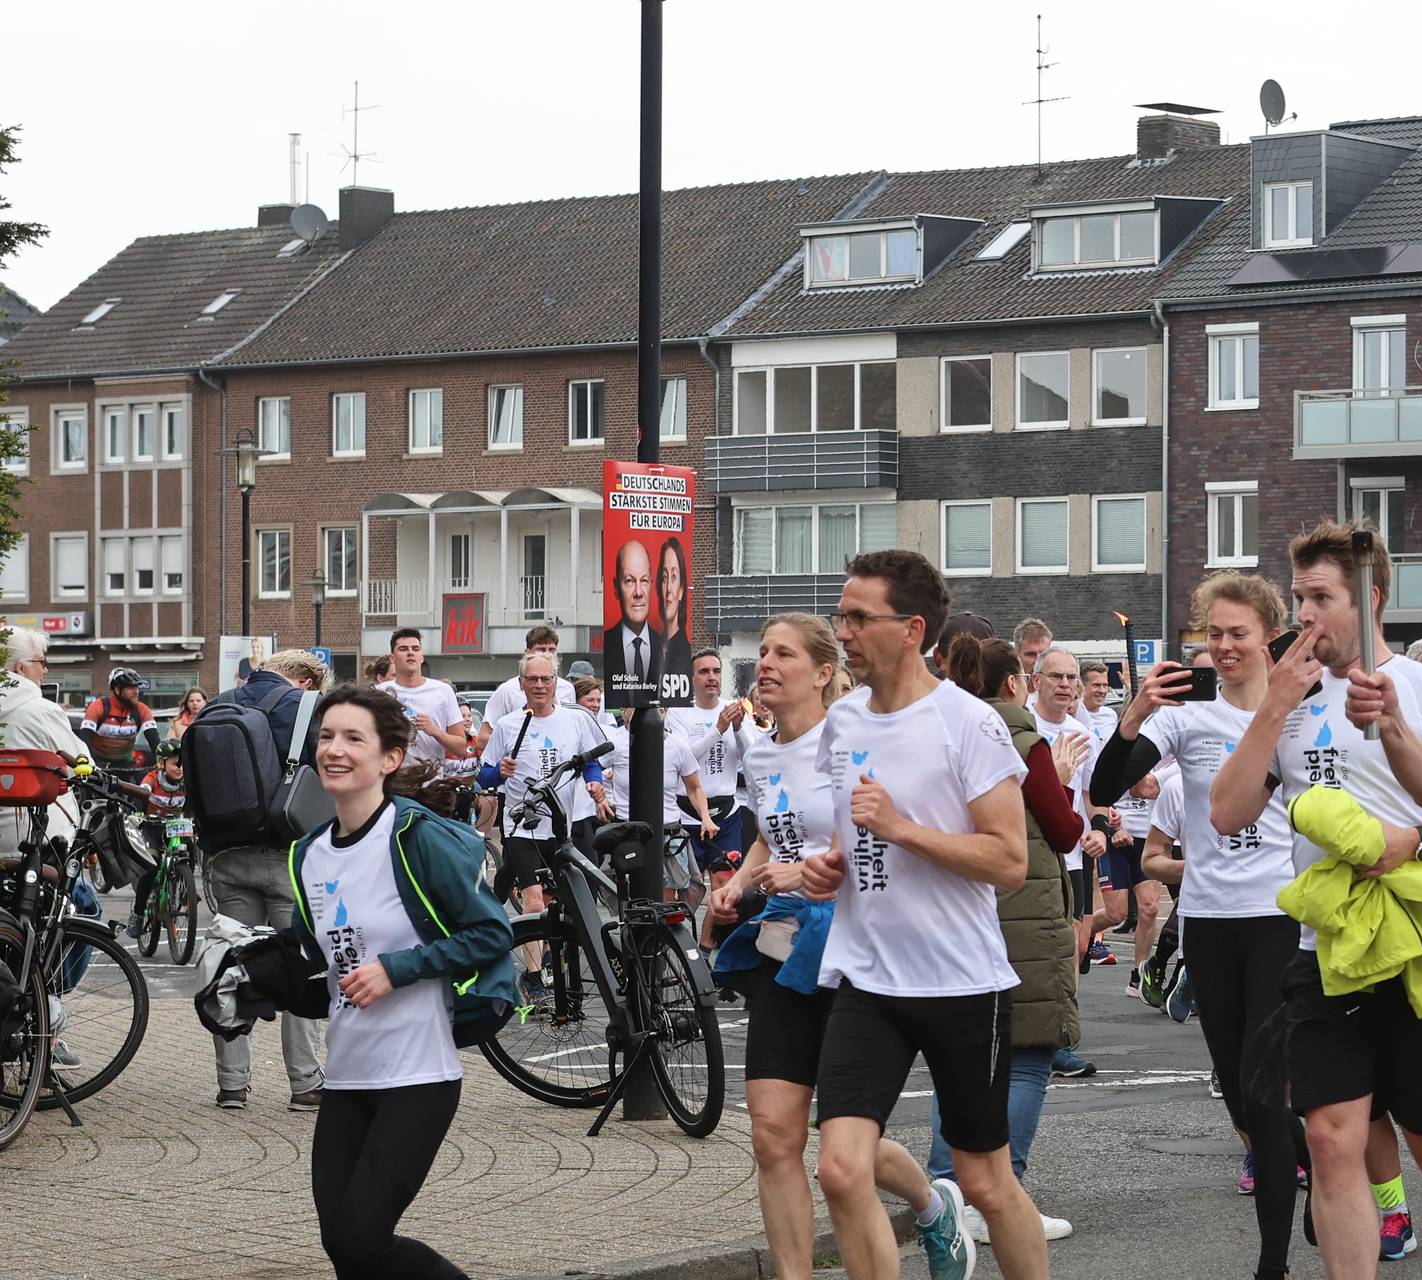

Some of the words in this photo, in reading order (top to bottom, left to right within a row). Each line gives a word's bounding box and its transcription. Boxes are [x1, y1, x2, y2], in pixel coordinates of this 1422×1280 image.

[623, 475, 685, 493] DEUTSCHLANDS
[611, 492, 657, 510] STÄRKSTE
[659, 496, 691, 512] STIMMEN
[631, 511, 650, 528] FÜR
[652, 514, 682, 530] EUROPA
[447, 606, 480, 646] kik
[315, 650, 326, 662] P
[1137, 643, 1150, 662] P
[612, 674, 624, 683] Olaf
[624, 674, 639, 683] Scholz
[612, 682, 622, 690] und
[642, 683, 657, 692] Barley
[662, 673, 690, 699] SPD
[609, 957, 624, 977] AXA
